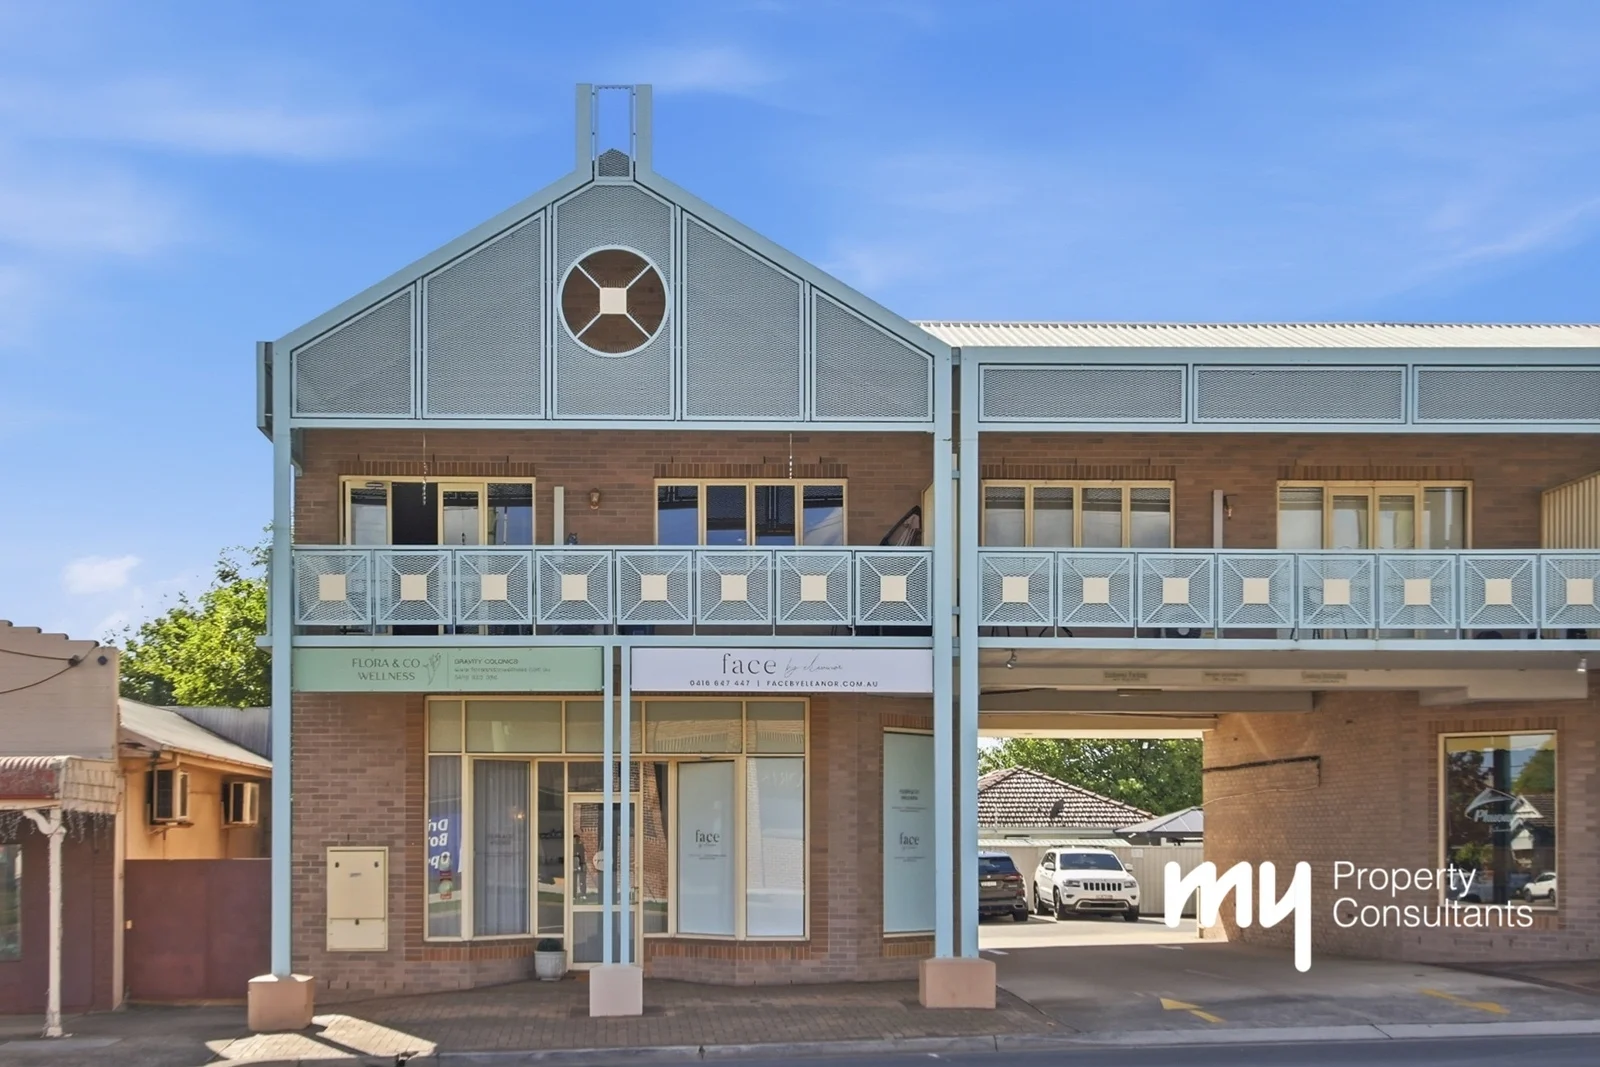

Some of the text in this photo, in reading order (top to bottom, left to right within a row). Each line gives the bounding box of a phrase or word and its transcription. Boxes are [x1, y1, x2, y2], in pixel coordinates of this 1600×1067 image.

[351, 658, 421, 668] FLORA & CO
[722, 653, 777, 675] face
[357, 671, 416, 681] WELLNESS
[766, 680, 879, 688] FACEBYELEANOR.COM.AU
[695, 829, 721, 843] face
[899, 831, 920, 846] face
